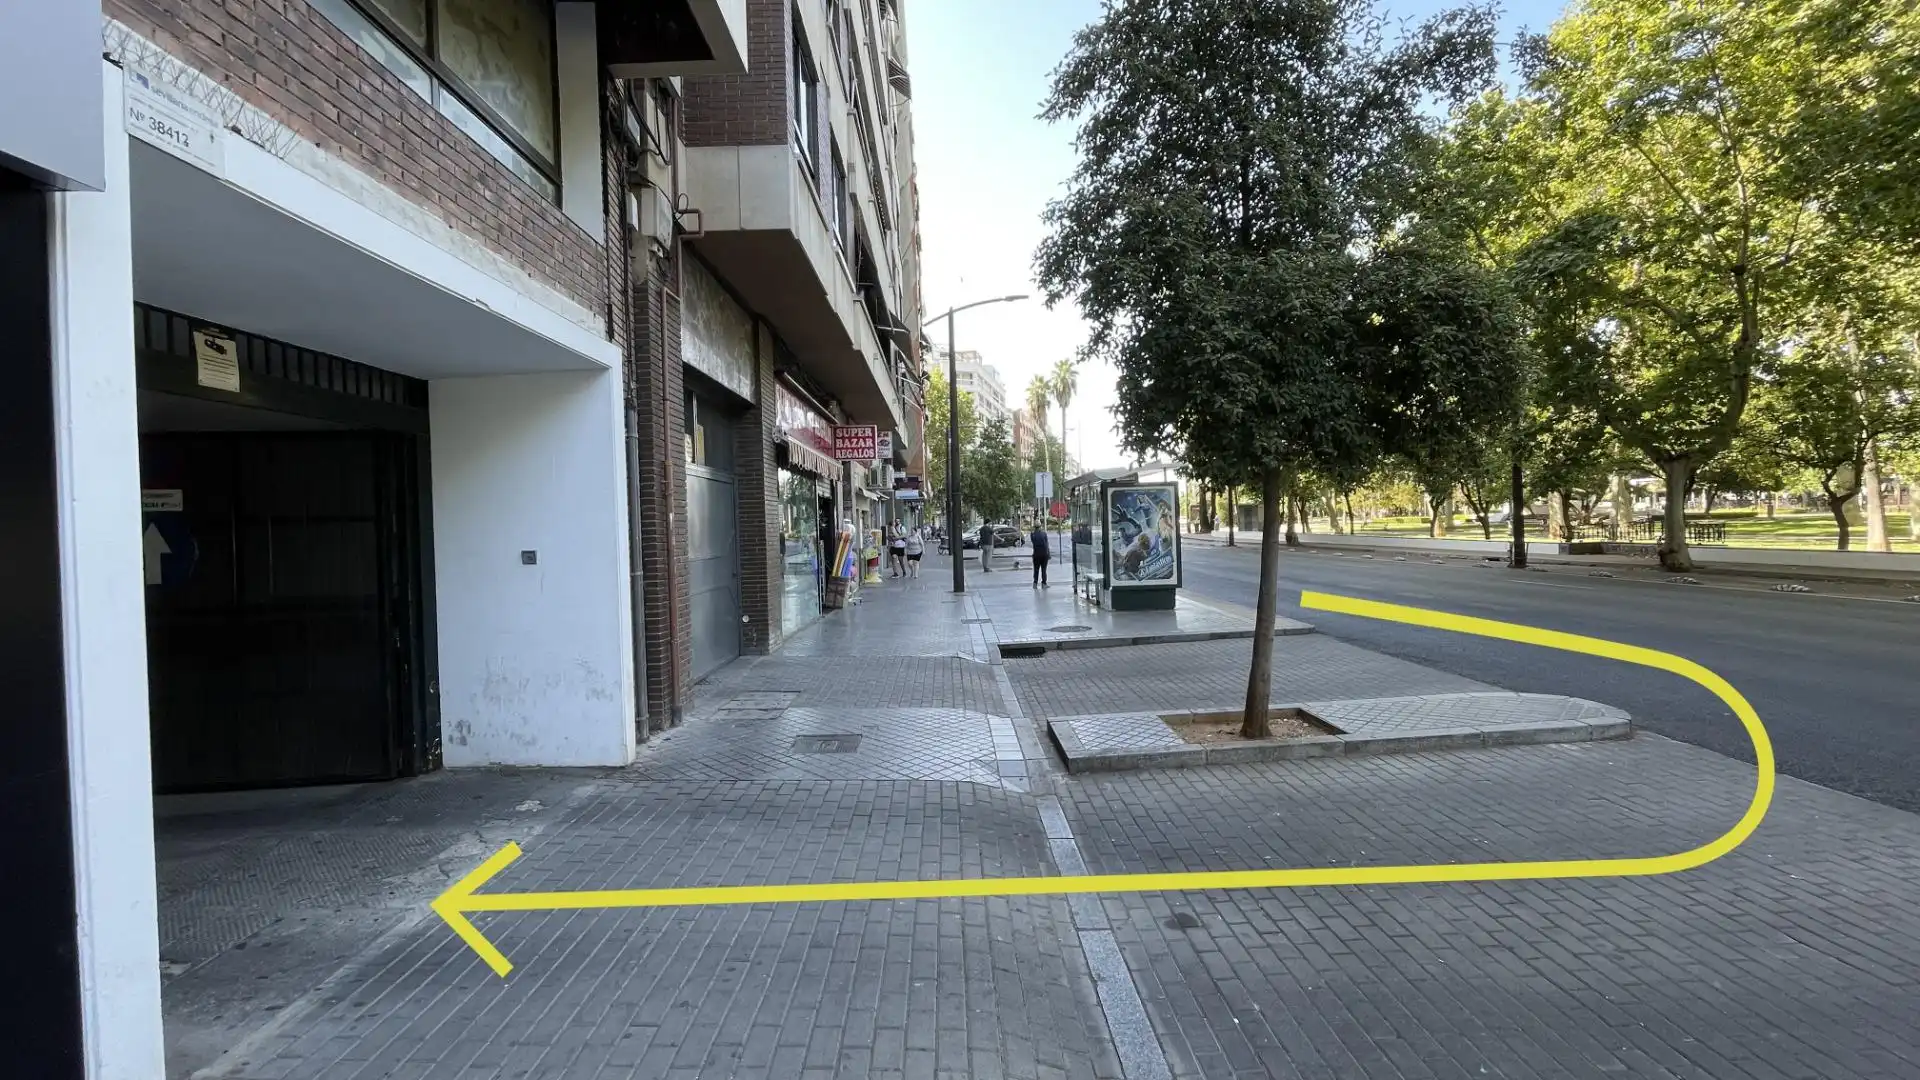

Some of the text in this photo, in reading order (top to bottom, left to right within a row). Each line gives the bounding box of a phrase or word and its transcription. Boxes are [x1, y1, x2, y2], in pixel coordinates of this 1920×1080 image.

[836, 428, 873, 437] SUPER
[835, 438, 874, 448] BAZAR
[835, 448, 875, 458] REGALOS
